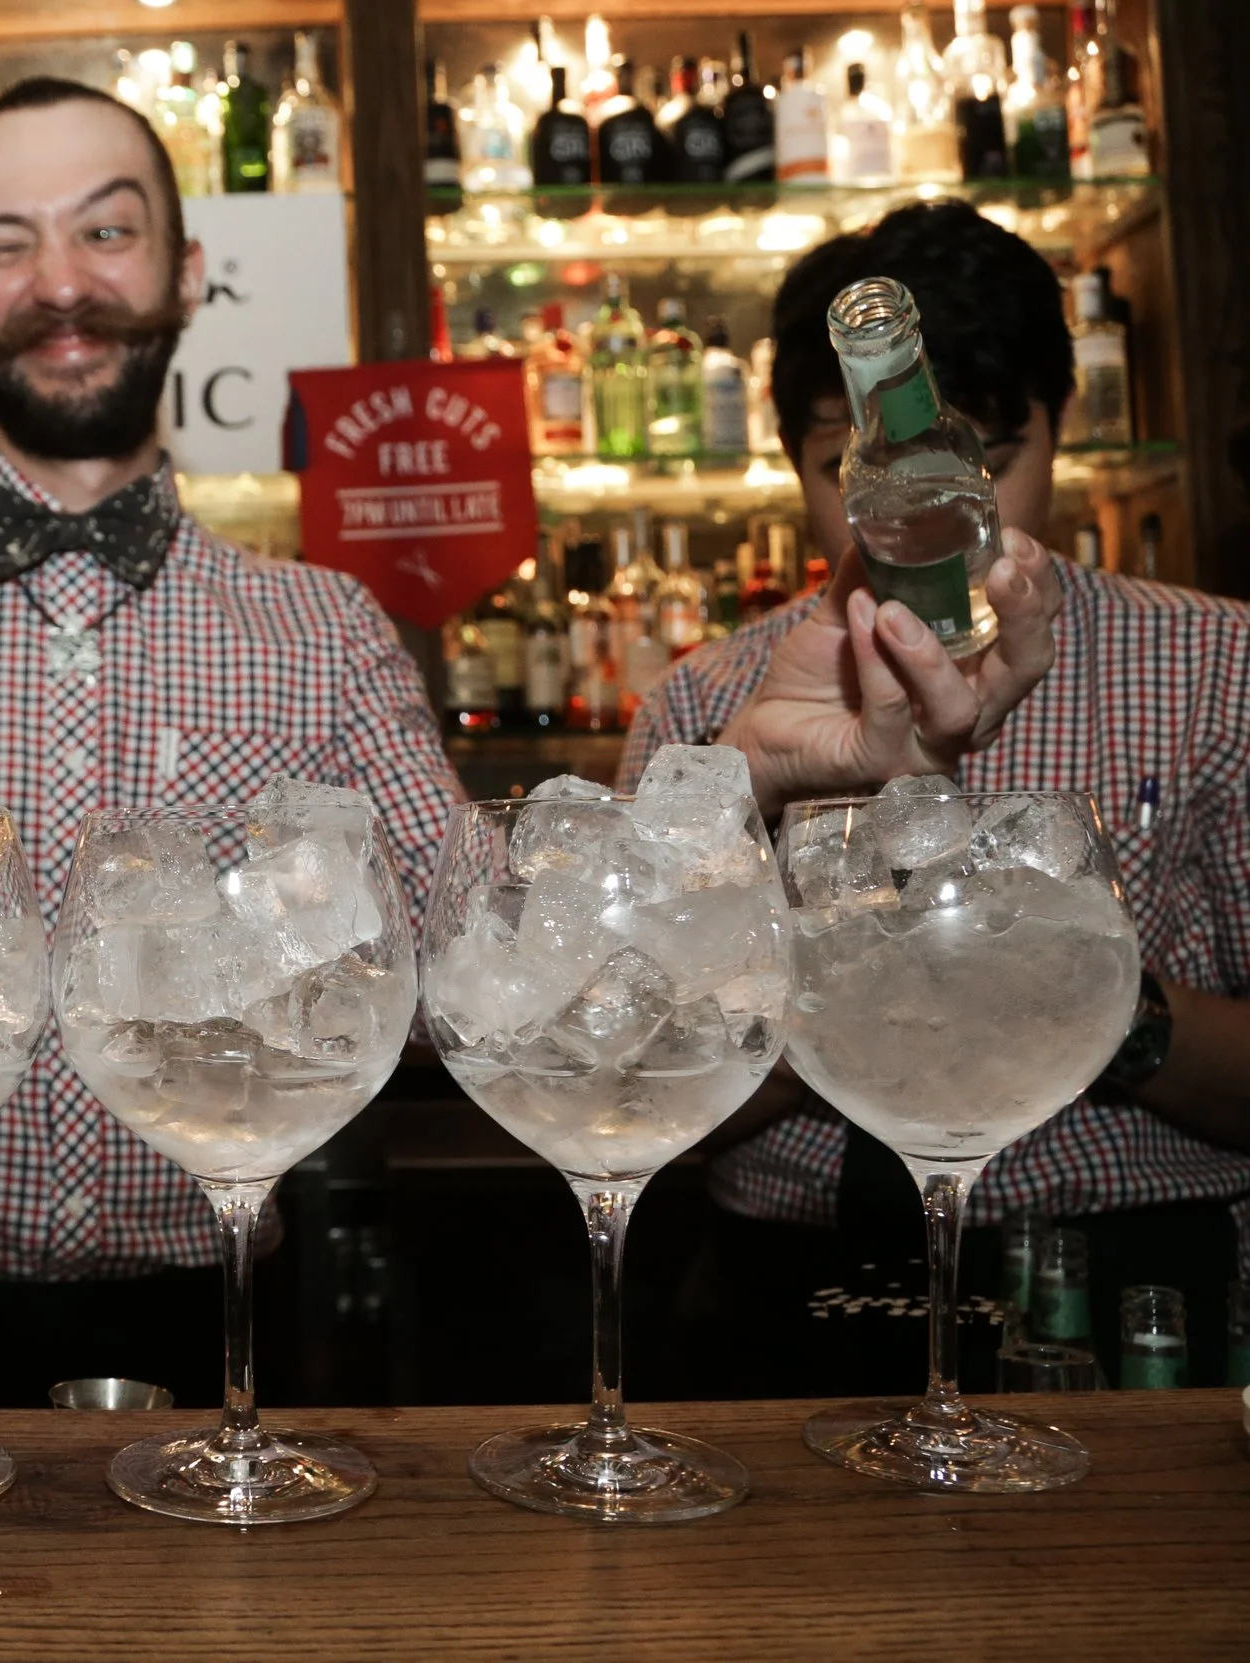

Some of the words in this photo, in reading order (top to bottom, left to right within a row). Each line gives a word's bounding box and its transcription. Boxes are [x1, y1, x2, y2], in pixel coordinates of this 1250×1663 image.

[324, 385, 414, 460] FRESH
[425, 386, 502, 451] CUTS
[377, 438, 450, 477] FREE
